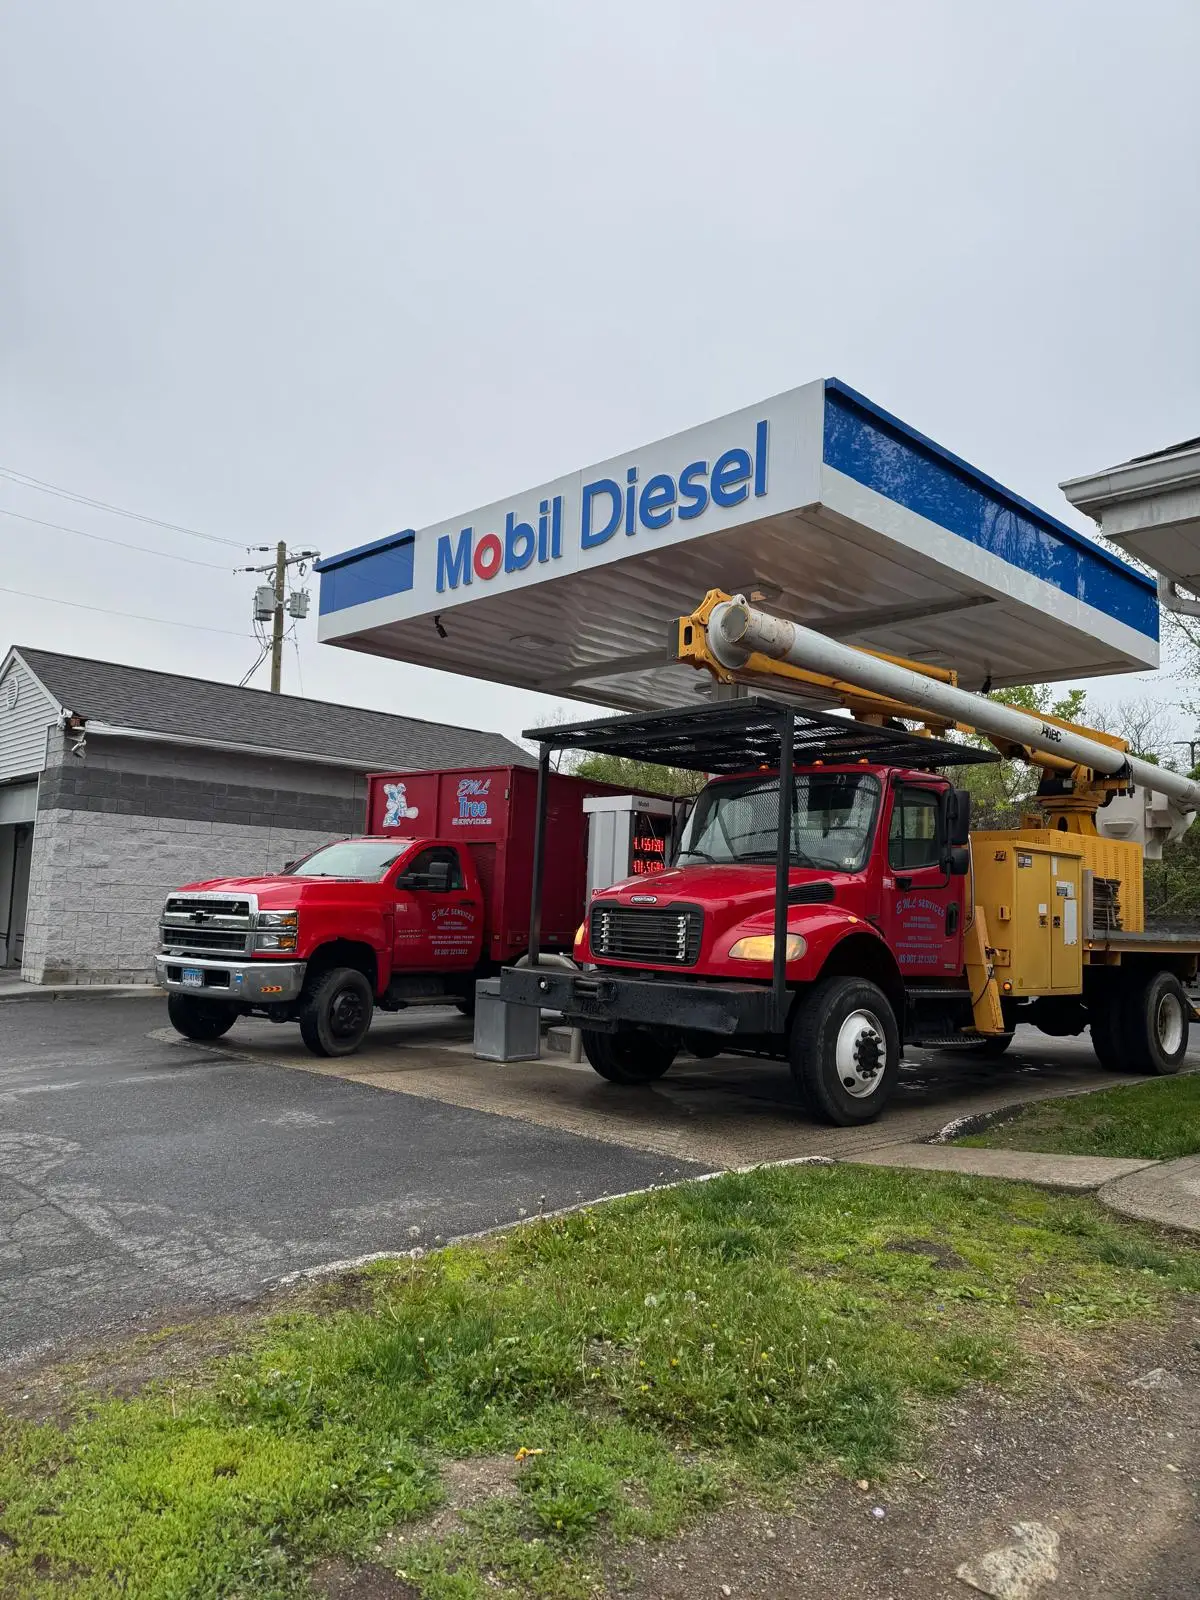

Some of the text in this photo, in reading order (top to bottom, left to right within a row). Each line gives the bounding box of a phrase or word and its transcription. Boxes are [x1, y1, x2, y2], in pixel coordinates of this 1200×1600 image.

[435, 418, 769, 594] Mobil Diesel
[458, 796, 488, 818] Tree
[918, 898, 945, 917] SERVICES
